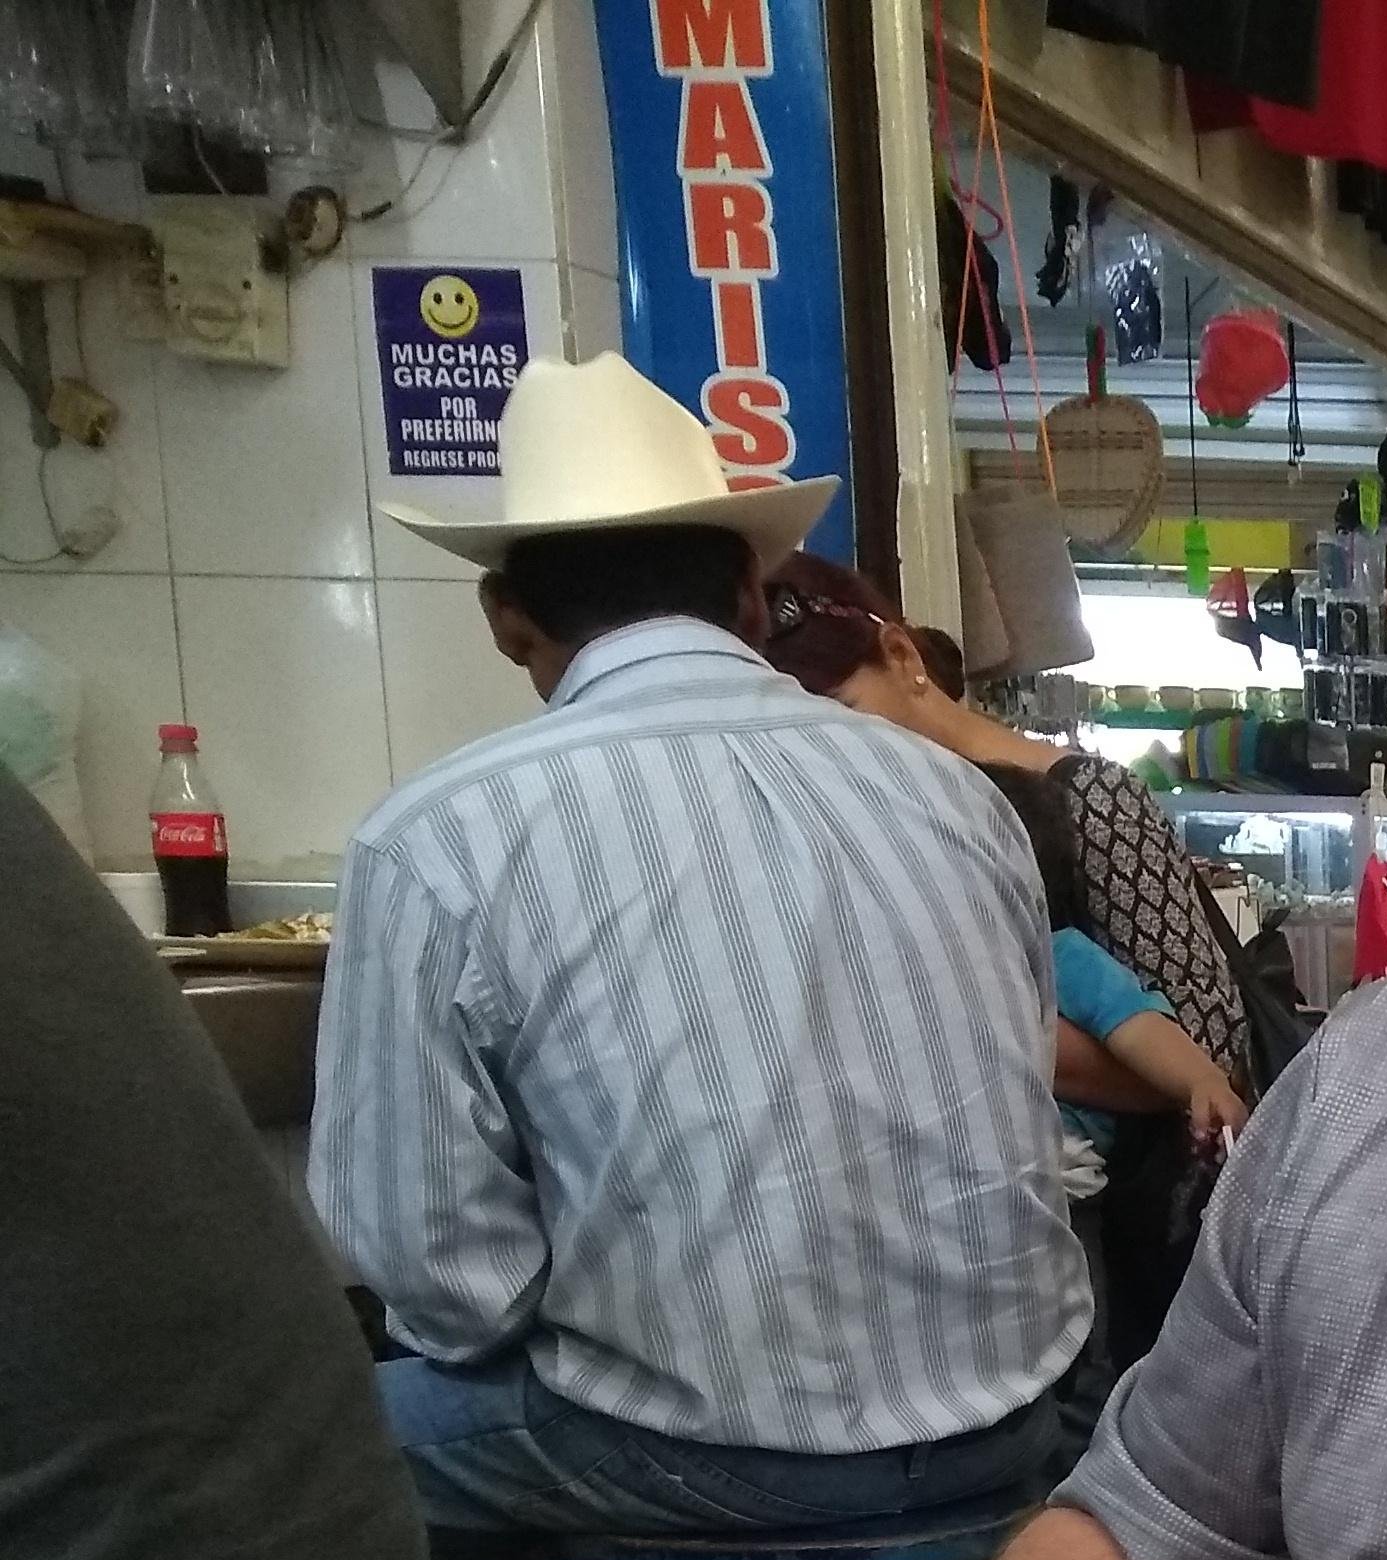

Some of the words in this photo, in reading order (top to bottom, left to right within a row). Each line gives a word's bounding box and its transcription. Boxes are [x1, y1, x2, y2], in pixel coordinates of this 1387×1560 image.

[652, 0, 796, 490] MARIS
[391, 343, 517, 365] MUCHAS
[393, 366, 517, 389] GRACIAS
[440, 396, 477, 418] POR
[401, 418, 501, 442] PREFERIRN
[403, 450, 465, 468] REGRESE
